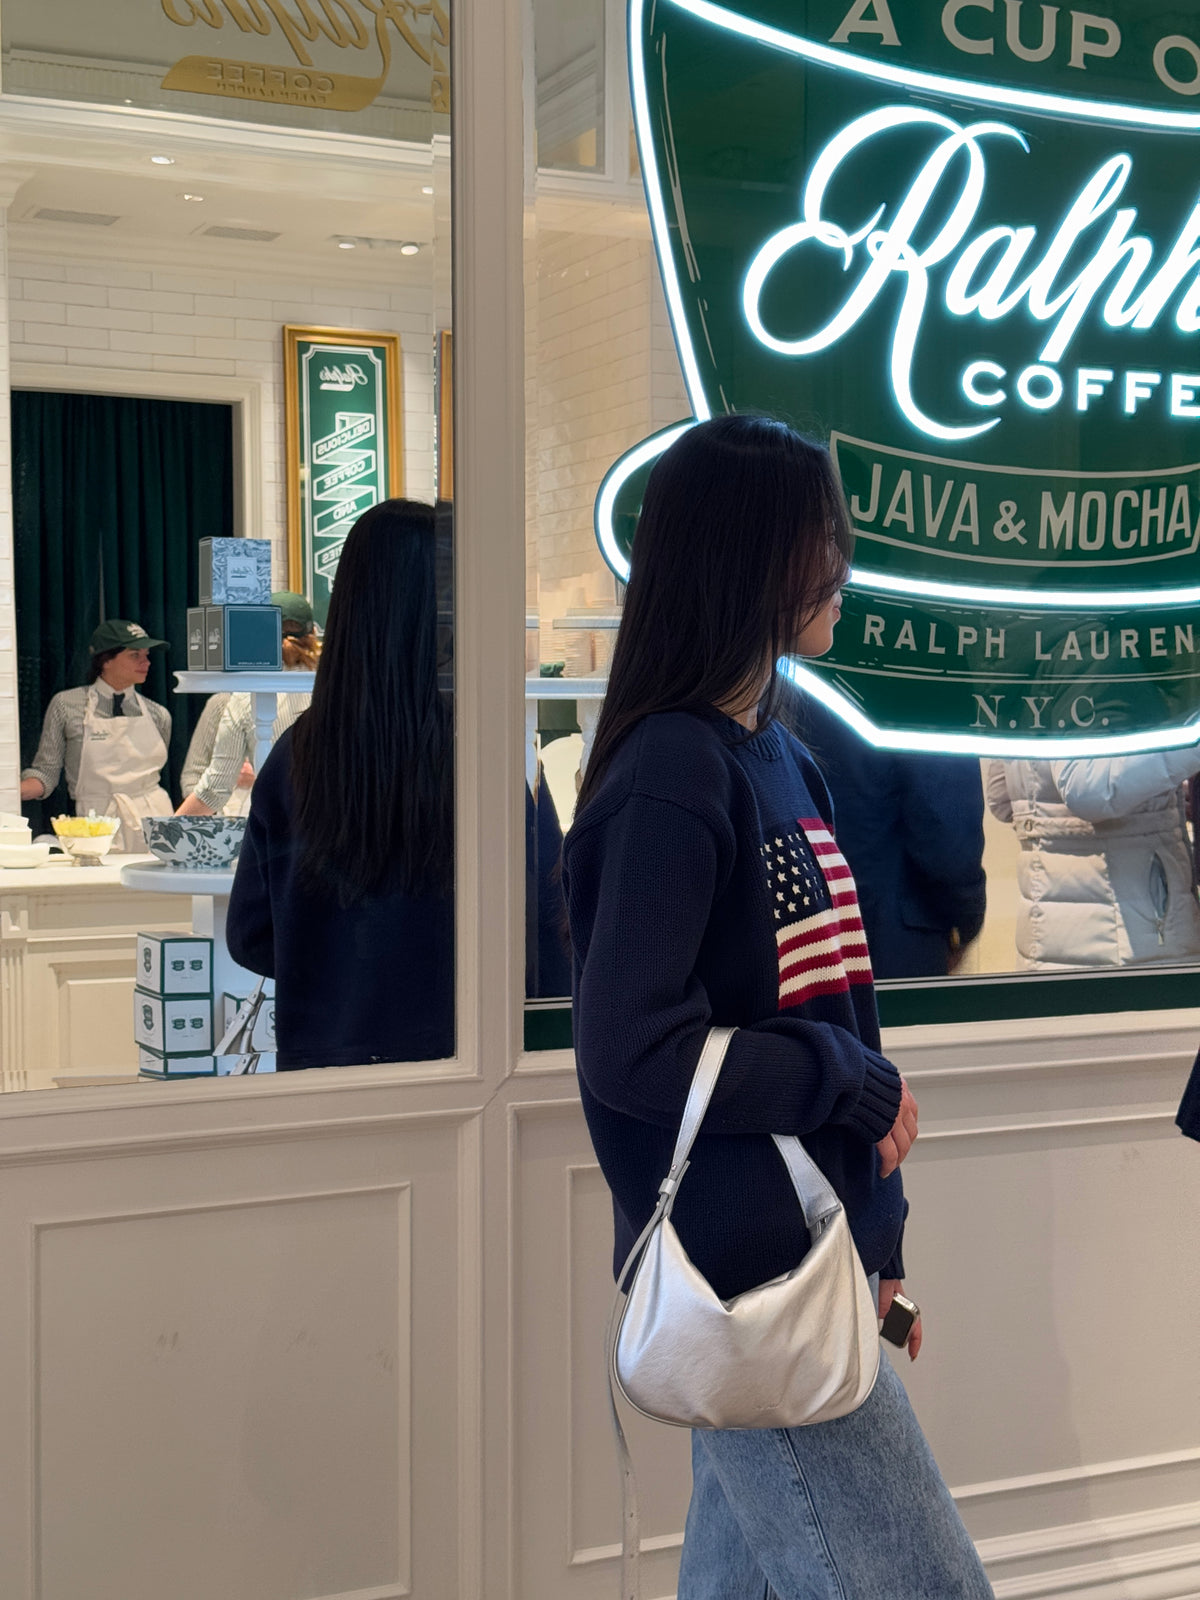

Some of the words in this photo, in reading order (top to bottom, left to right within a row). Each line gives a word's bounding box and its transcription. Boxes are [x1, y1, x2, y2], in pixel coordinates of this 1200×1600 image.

[828, 0, 902, 47] A
[941, 0, 1121, 70] CUP
[850, 463, 980, 546] JAVA
[993, 500, 1028, 545] &
[1038, 484, 1192, 551] MOCHA
[862, 613, 1006, 659] RALPH
[1035, 624, 1195, 661] LAUREN
[969, 694, 1110, 729] N.Y.C.
